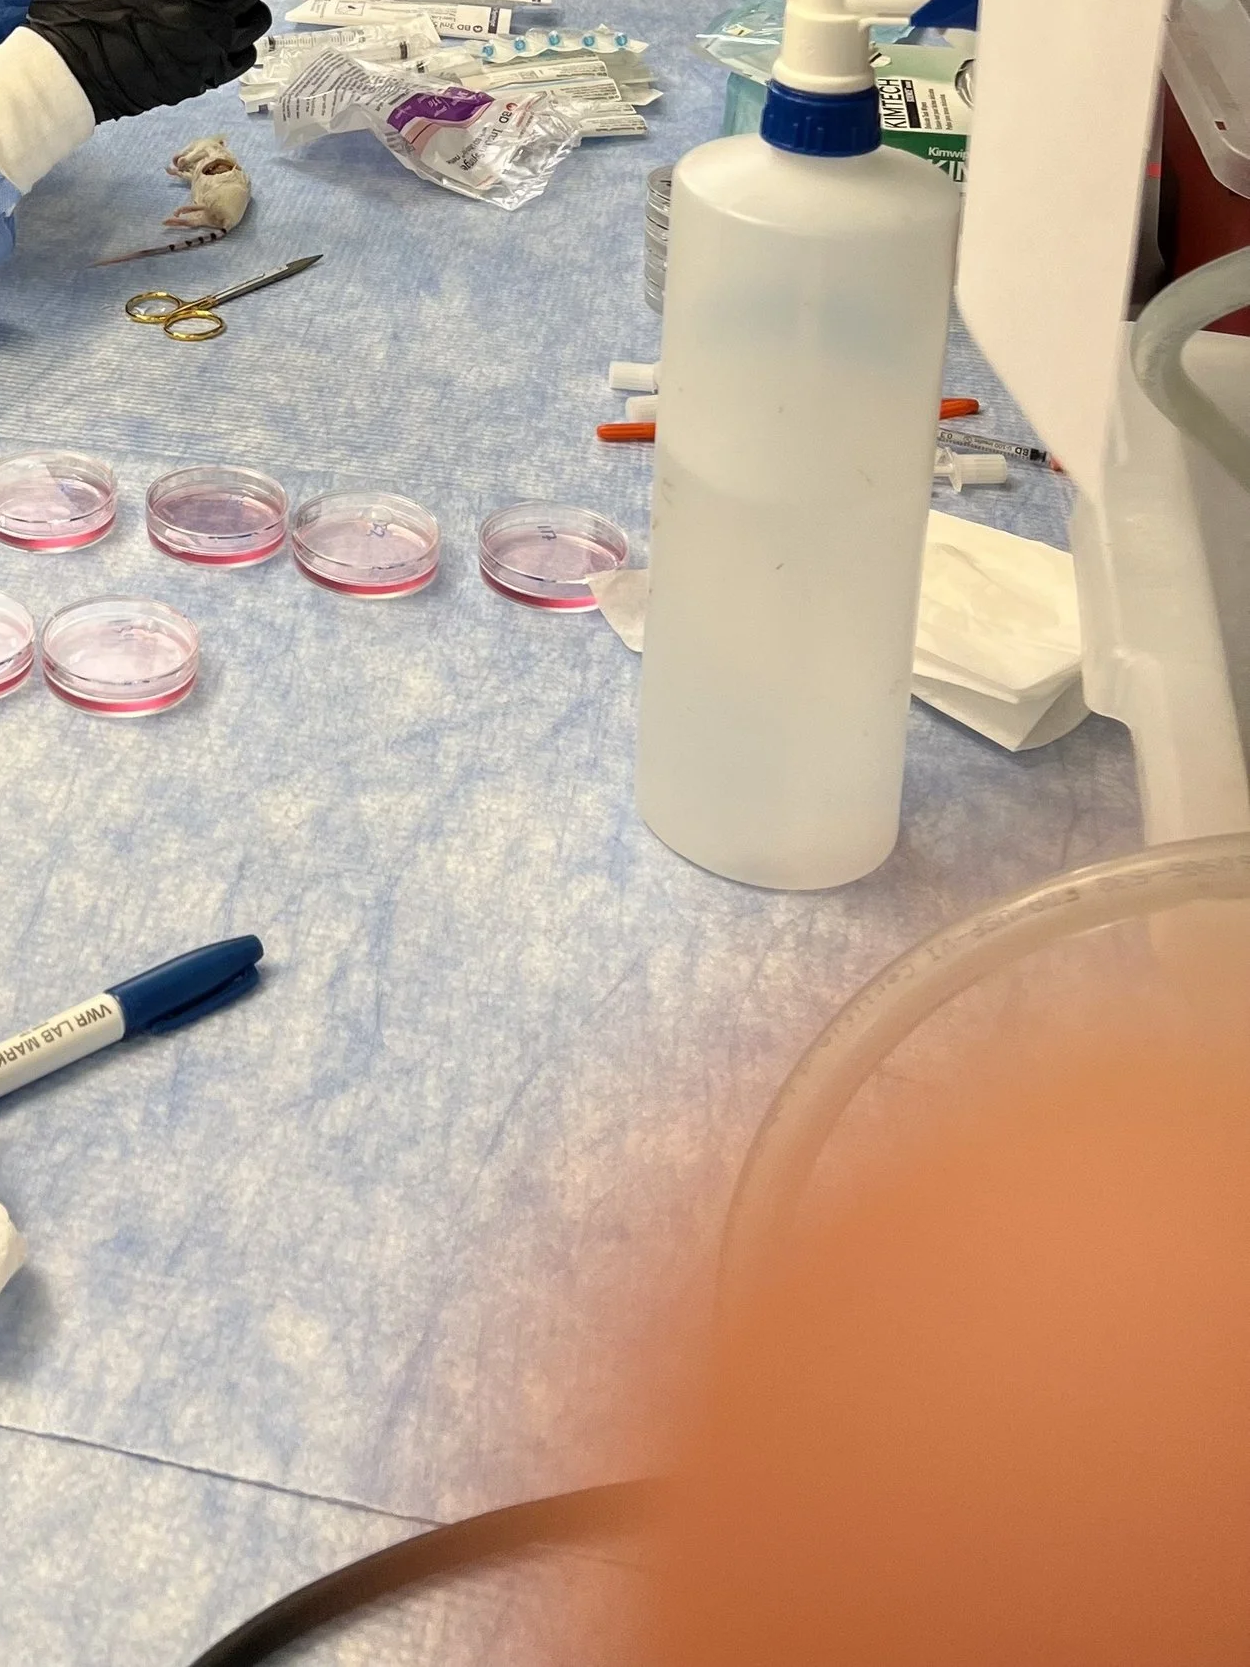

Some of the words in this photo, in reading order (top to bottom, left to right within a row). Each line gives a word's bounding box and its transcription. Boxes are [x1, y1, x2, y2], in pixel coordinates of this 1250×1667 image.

[457, 24, 471, 32] BD
[877, 78, 908, 129] KIMTECH
[499, 111, 513, 124] BD
[1014, 446, 1030, 457] BD
[73, 1003, 113, 1027] VWR
[40, 1019, 75, 1043] LAB
